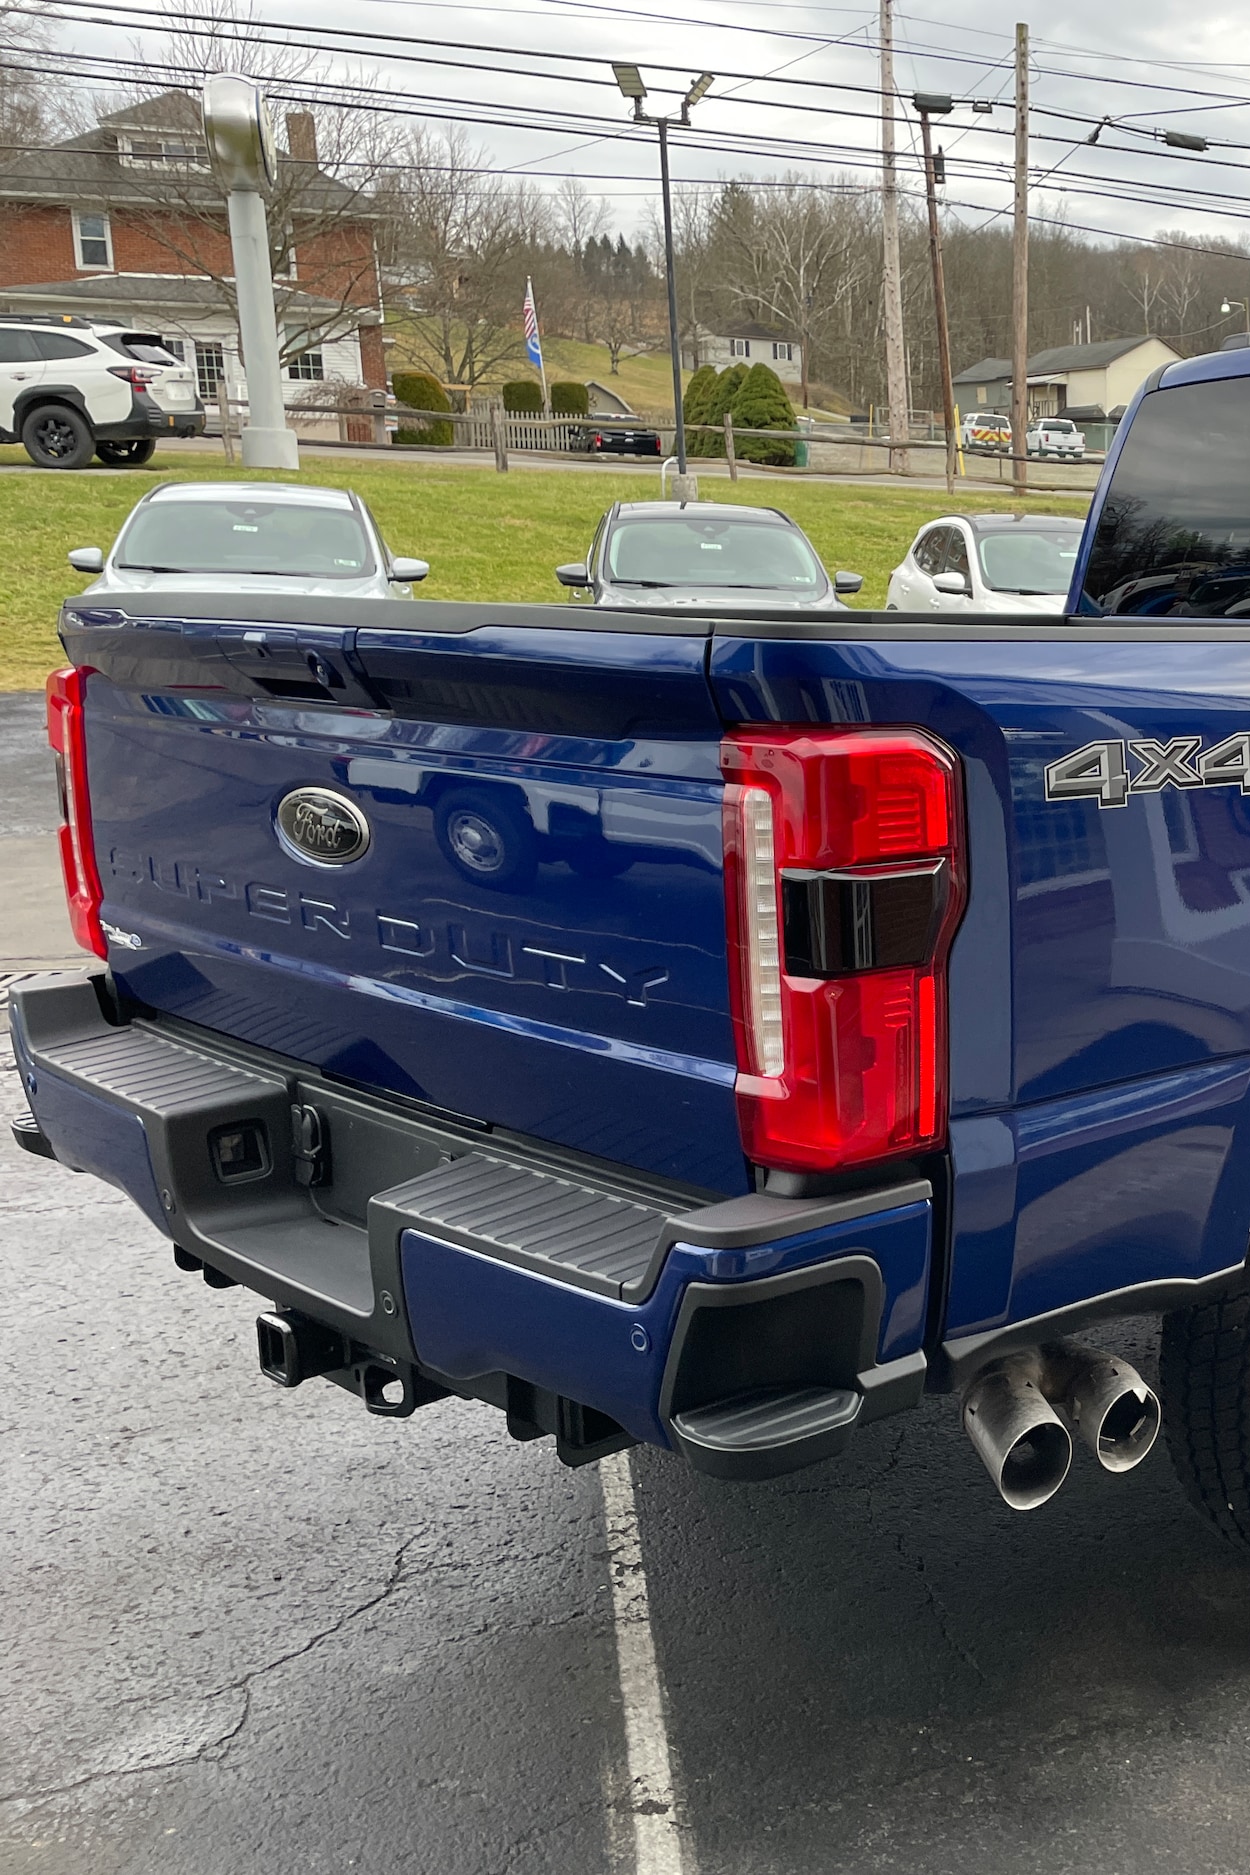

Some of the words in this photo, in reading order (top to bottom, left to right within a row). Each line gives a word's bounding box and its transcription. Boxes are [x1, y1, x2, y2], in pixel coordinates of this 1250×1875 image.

[292, 802, 341, 848] Ford
[110, 847, 350, 939] SUPER
[375, 909, 669, 1007] DUTY
